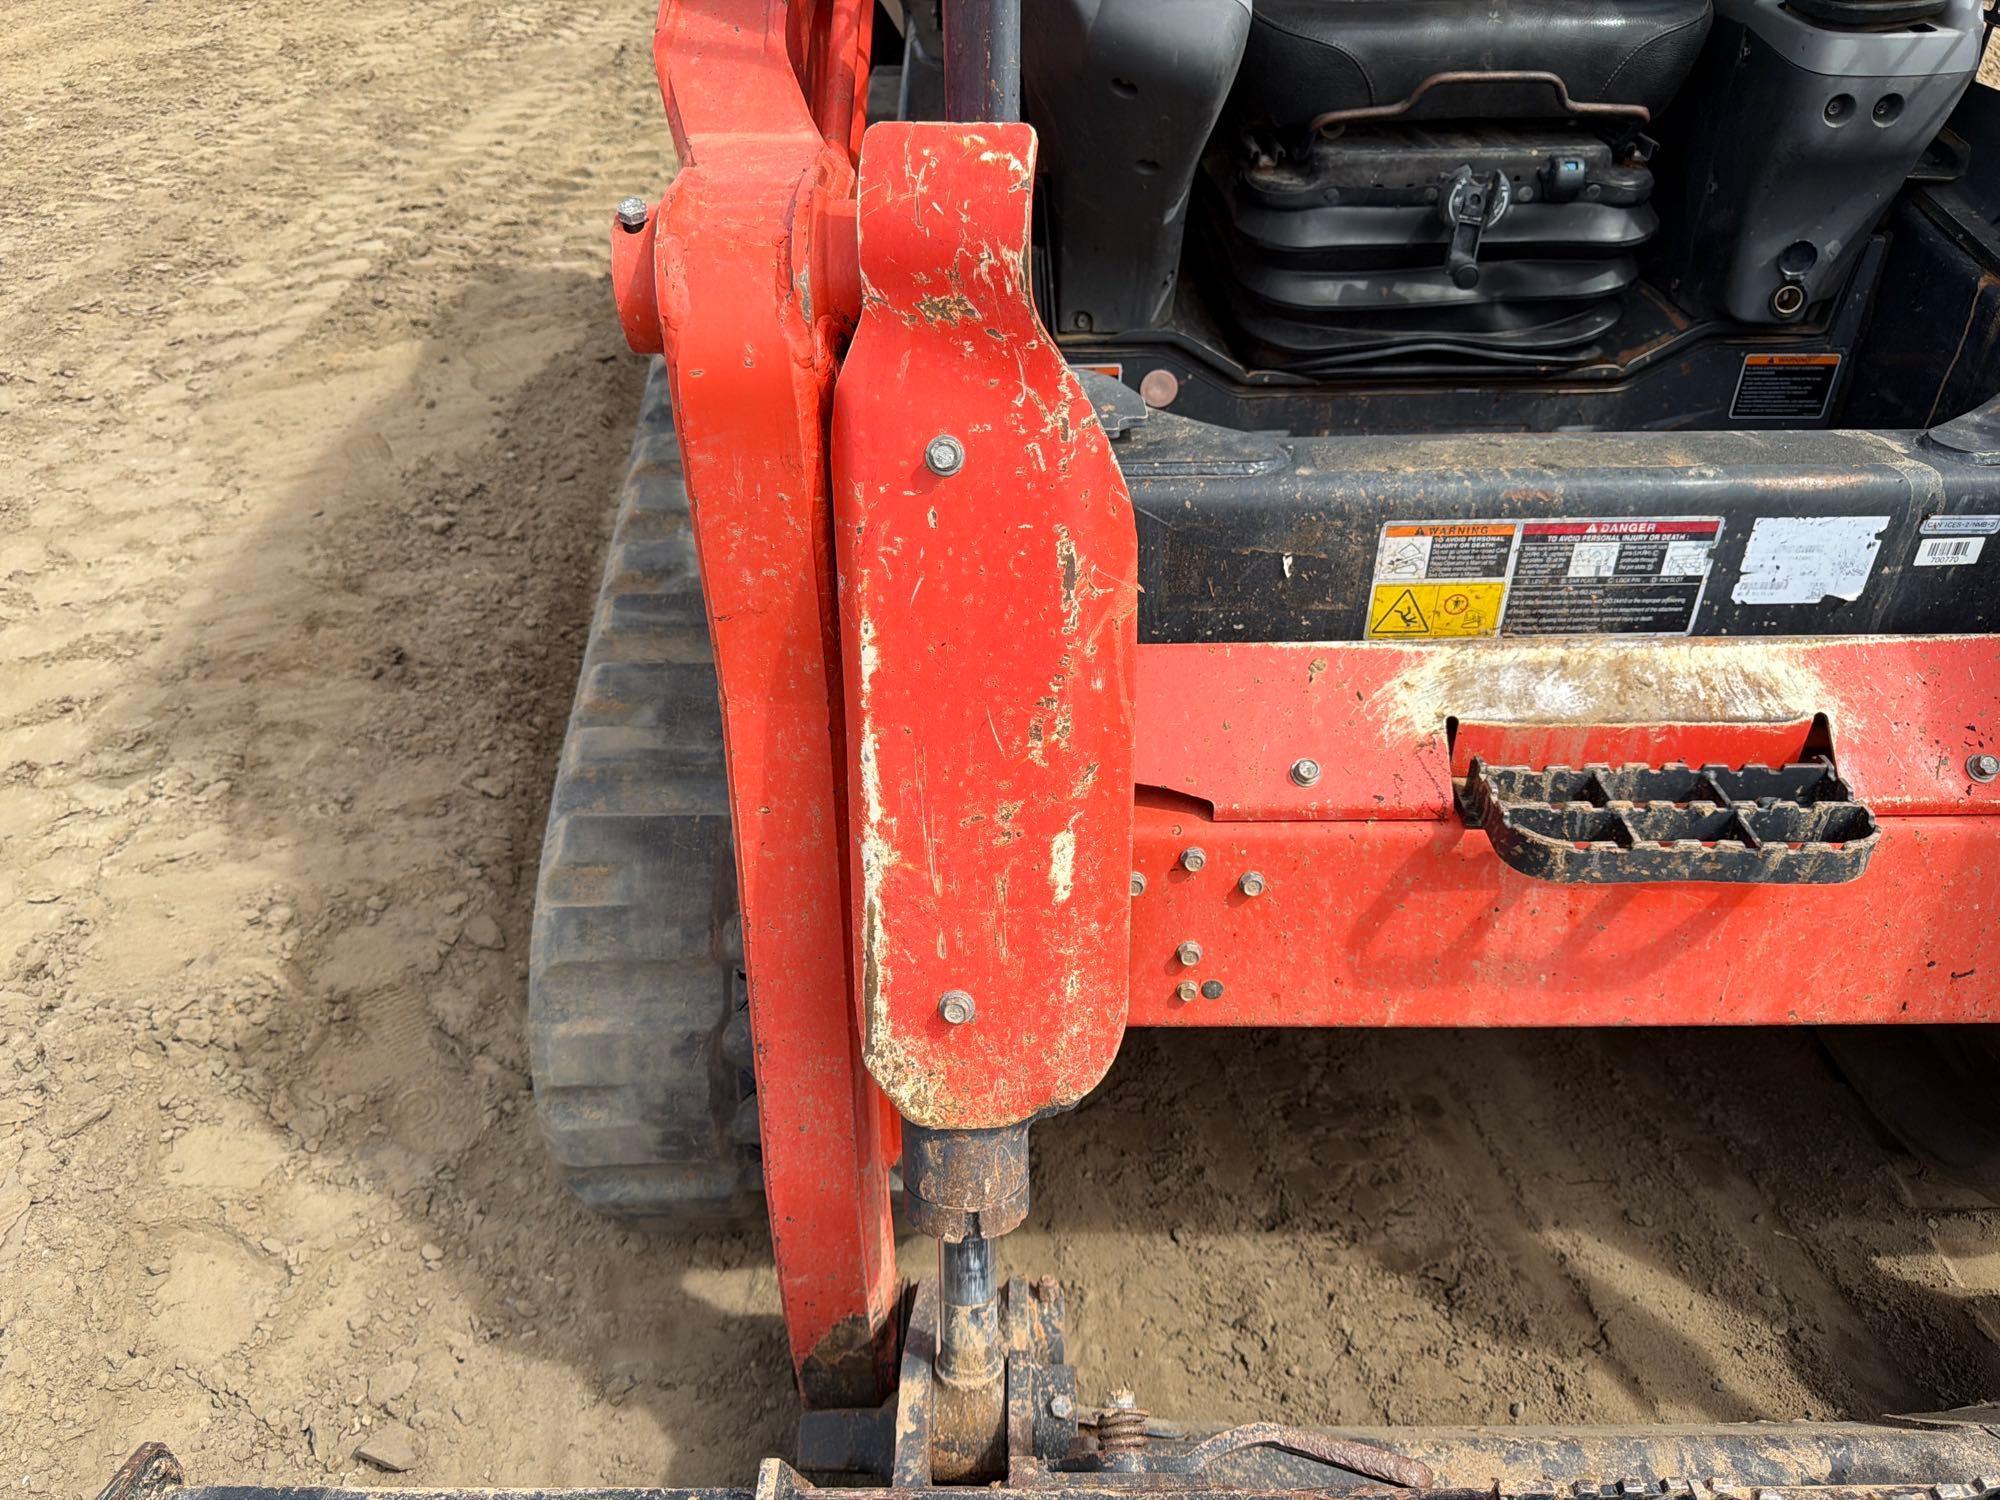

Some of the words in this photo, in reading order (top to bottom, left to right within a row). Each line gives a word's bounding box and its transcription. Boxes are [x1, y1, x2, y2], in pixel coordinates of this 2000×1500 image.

[1428, 526, 1489, 535] WARNING
[1600, 523, 1656, 533] DANGER
[1581, 534, 1621, 542] PERSONAL
[1621, 534, 1648, 542] INJURY
